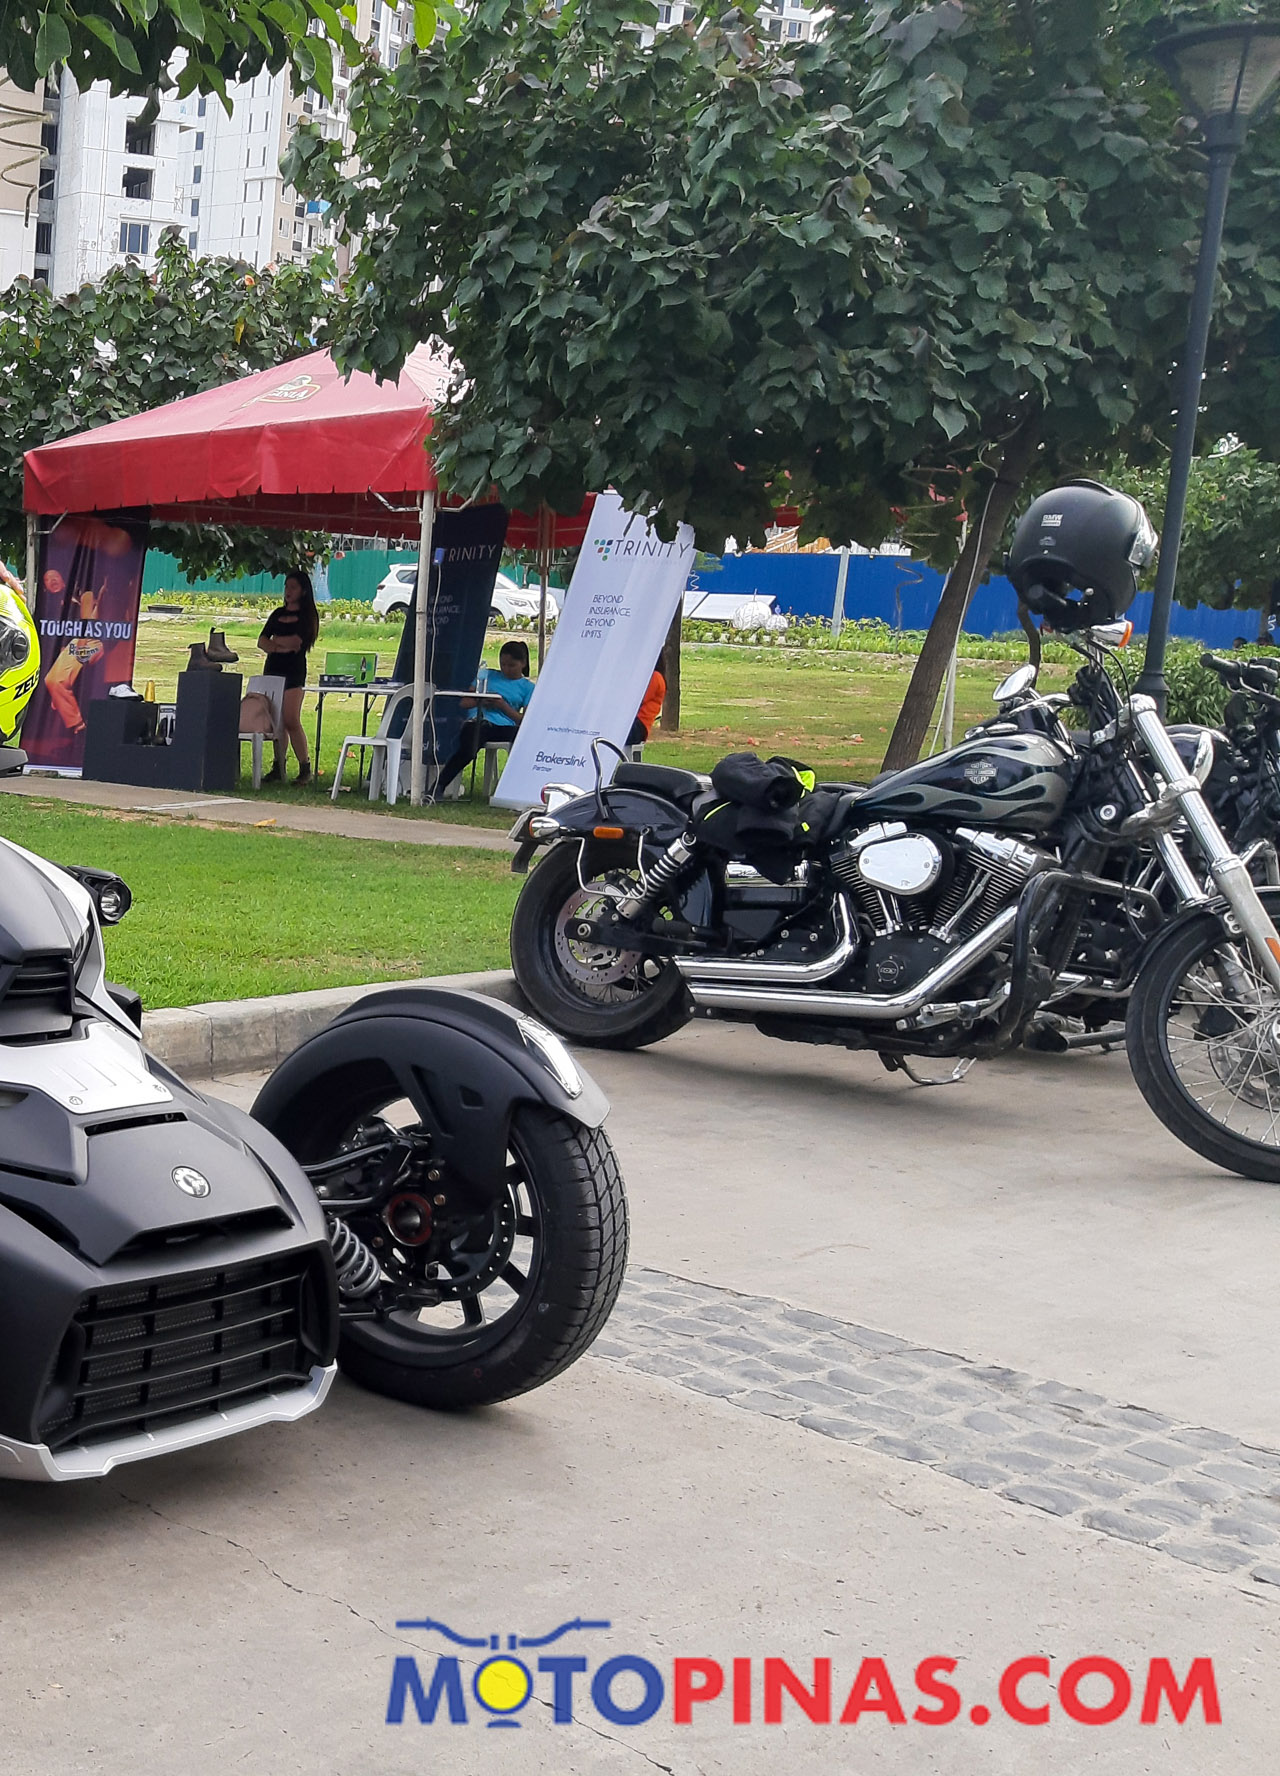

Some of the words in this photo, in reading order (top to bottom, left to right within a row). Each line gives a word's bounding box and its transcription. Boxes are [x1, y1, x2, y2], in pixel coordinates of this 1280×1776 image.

[443, 544, 497, 562] RINITY
[614, 540, 691, 559] TRINITY
[592, 595, 624, 604] BEYOND
[588, 606, 631, 617] INSURANCE
[40, 619, 82, 637] TOUGH
[84, 621, 102, 638] AS
[105, 622, 132, 640] YOU
[585, 618, 616, 627] BEYOND
[580, 630, 602, 639] LIMITS
[535, 750, 587, 768] Brokerslink
